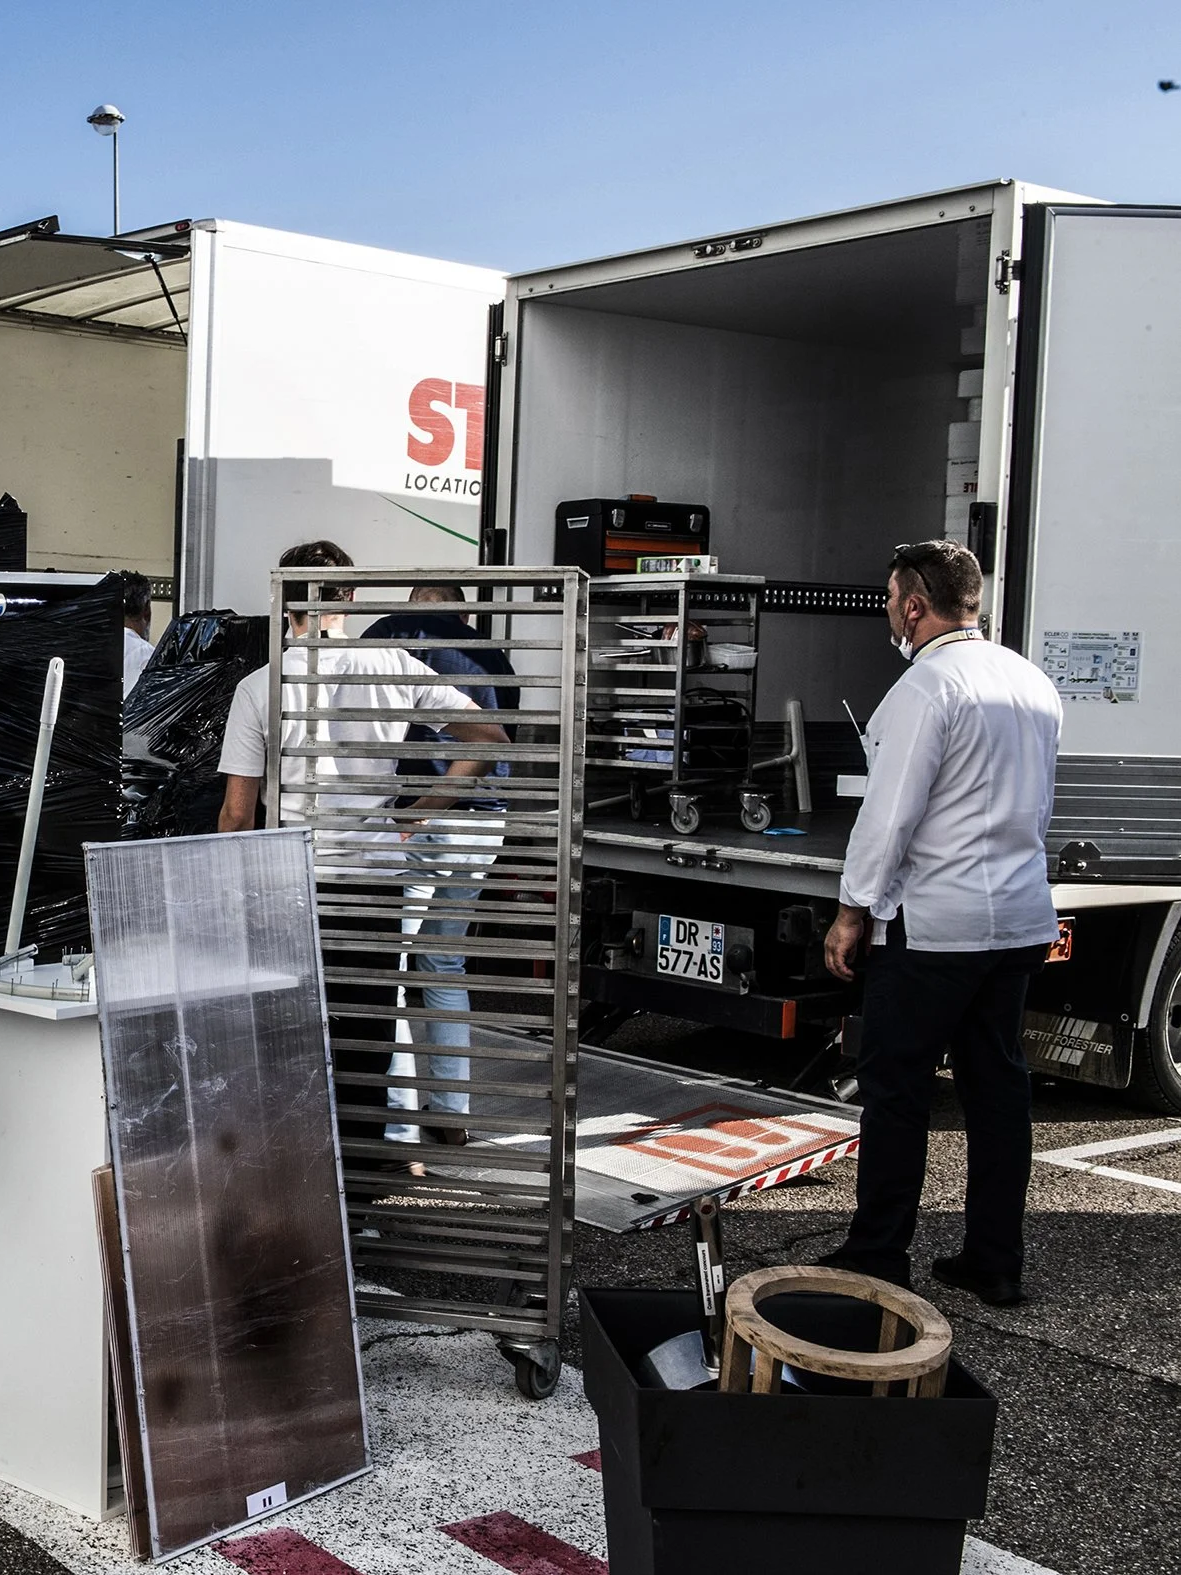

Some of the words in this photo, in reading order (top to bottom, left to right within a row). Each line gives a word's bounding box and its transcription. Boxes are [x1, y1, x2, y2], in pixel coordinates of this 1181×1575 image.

[407, 378, 484, 470] ST
[405, 473, 483, 496] LOCATIO
[712, 940, 722, 952] 93
[658, 946, 721, 980] 577-AS
[1022, 1028, 1053, 1042] PETIT
[1053, 1034, 1114, 1055] FORESTIER
